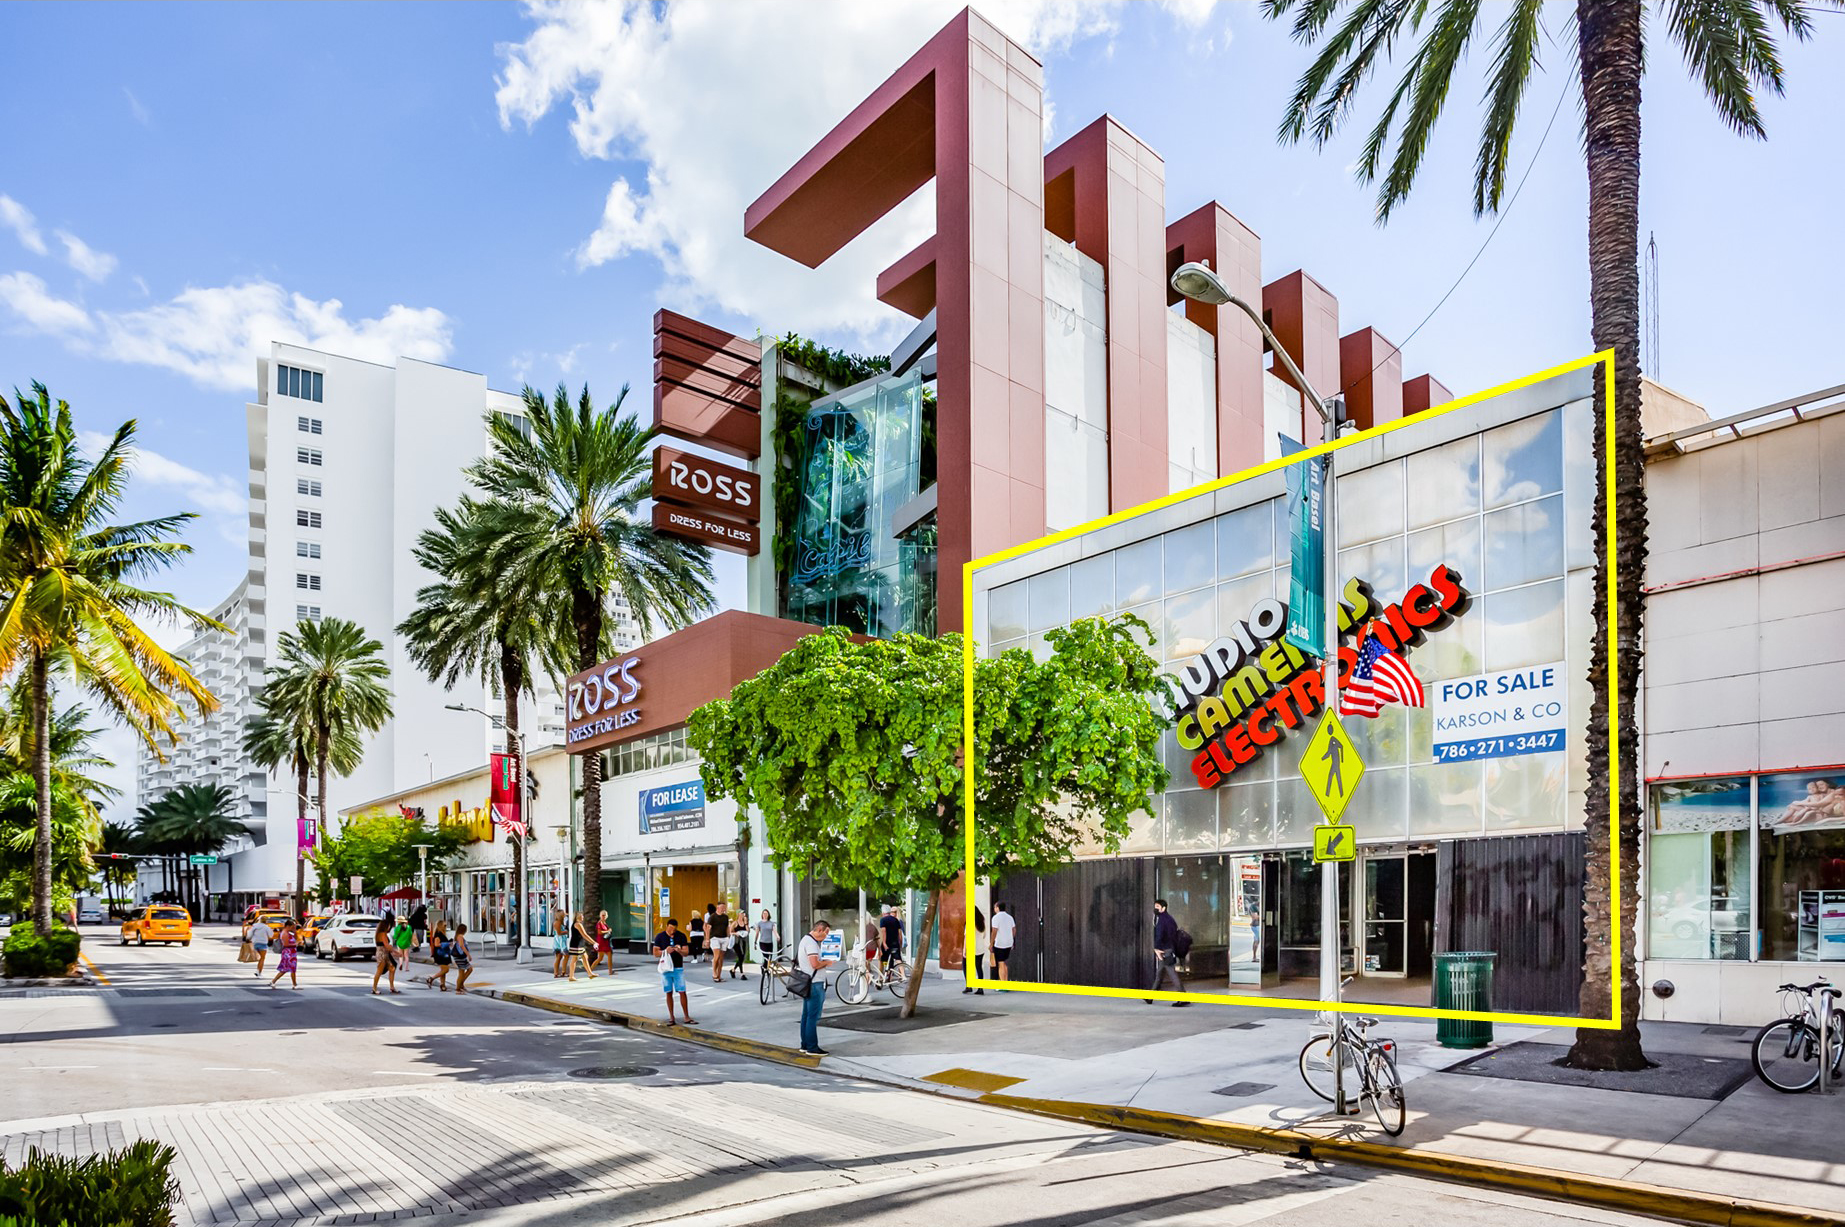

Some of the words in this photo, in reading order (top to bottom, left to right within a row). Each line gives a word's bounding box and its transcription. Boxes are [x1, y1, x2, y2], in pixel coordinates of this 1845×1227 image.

[671, 461, 751, 506] ROSS
[1310, 460, 1319, 485] Art
[670, 513, 702, 529] DRESS
[705, 522, 725, 535] FOR
[727, 528, 751, 541] LESS
[1310, 488, 1320, 532] Basel
[569, 657, 641, 722] ROSS
[1443, 680, 1488, 702] FOR
[1497, 668, 1554, 694] SALE
[569, 723, 594, 743] DRESS
[595, 716, 613, 735] FOR
[614, 709, 640, 730] LESS
[1437, 709, 1506, 731] KARSON
[1513, 707, 1525, 720] &
[1532, 702, 1561, 718] CO
[652, 791, 670, 807] FOR
[670, 786, 698, 804] LEASE
